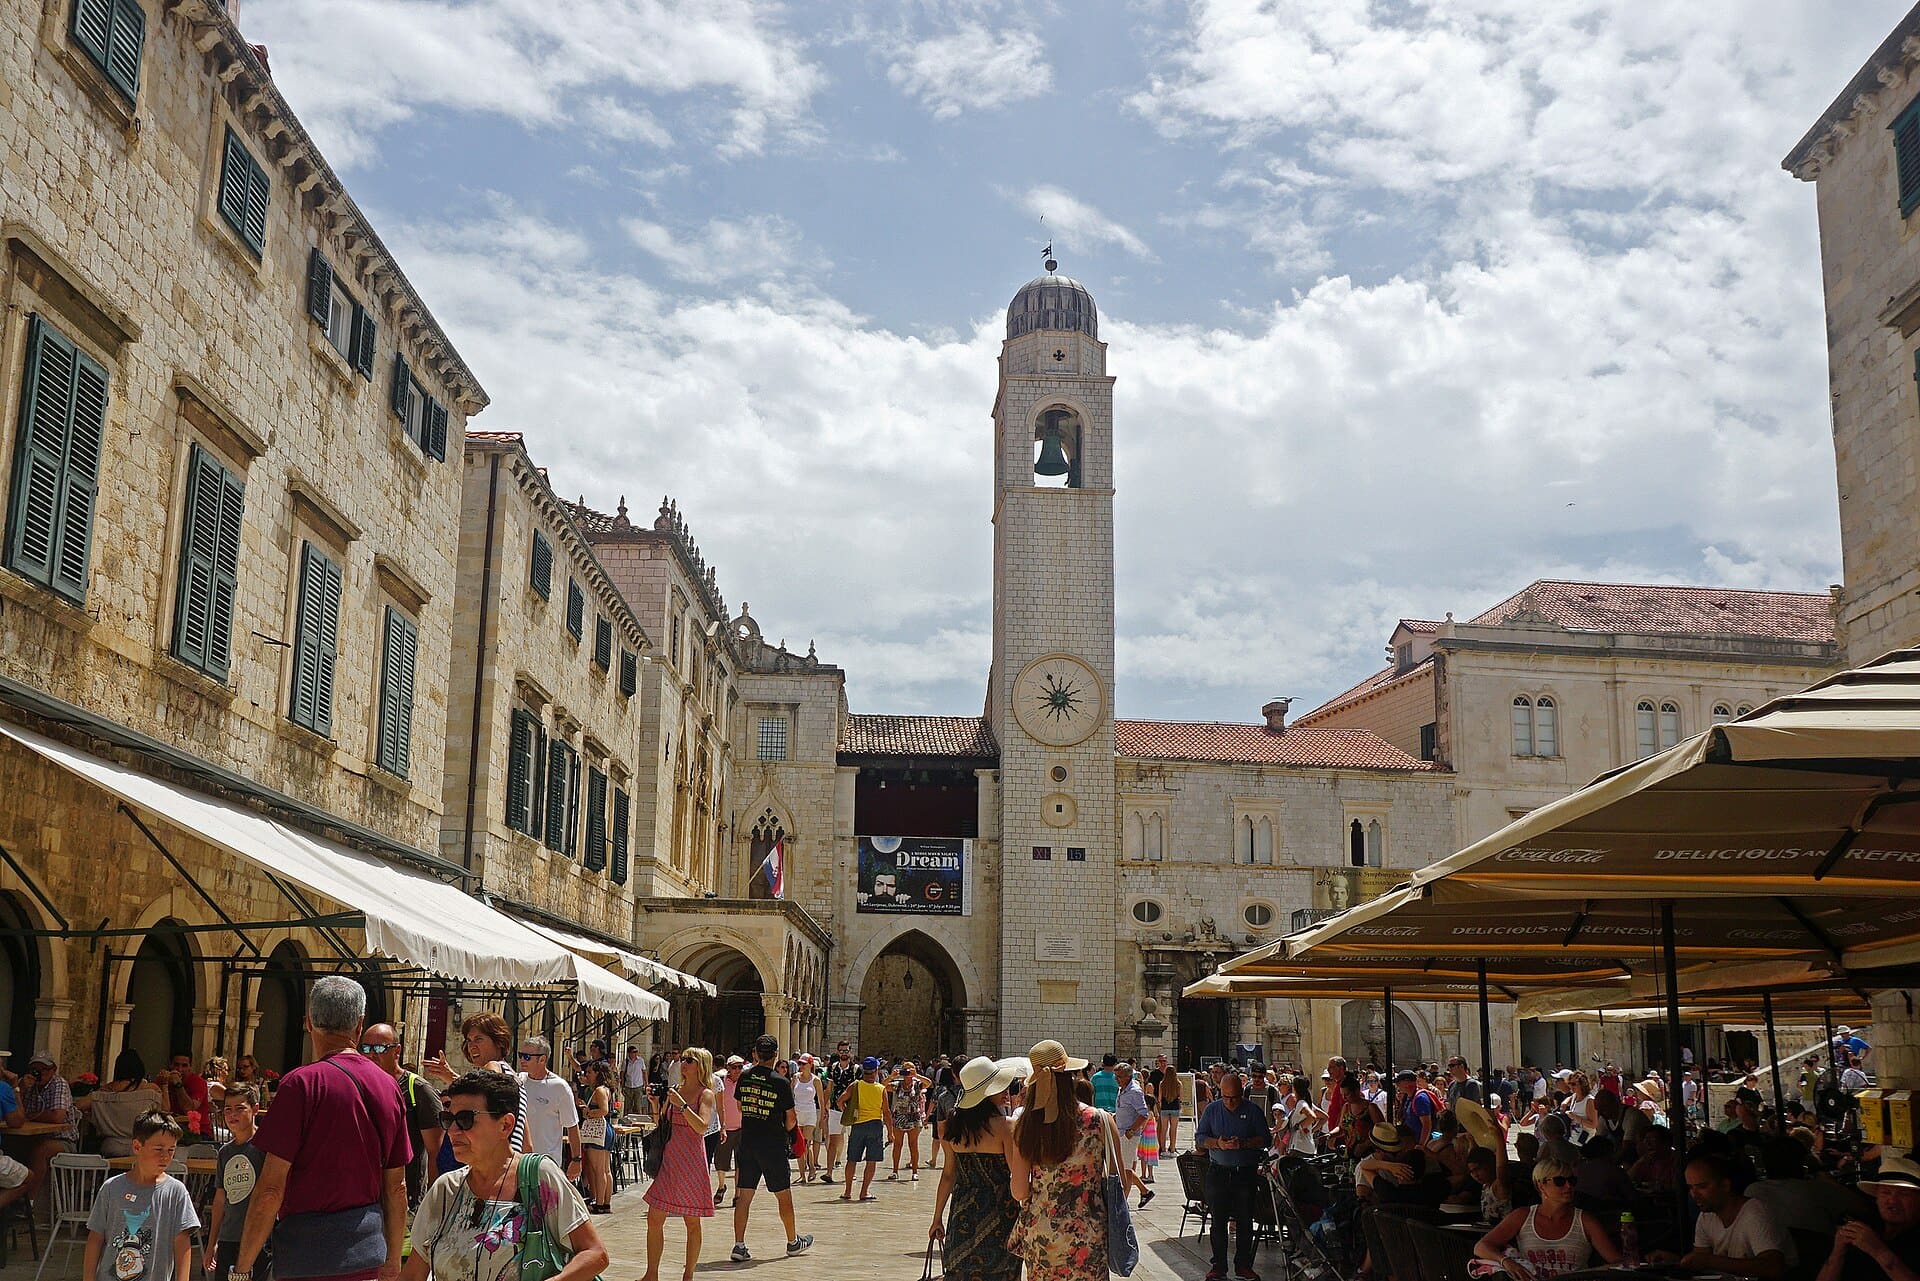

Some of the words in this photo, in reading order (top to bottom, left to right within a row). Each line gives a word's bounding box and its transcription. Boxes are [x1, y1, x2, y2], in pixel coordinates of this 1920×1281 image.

[896, 851, 960, 870] Dream
[1495, 847, 1611, 863] Coca-Cola
[1654, 848, 1801, 861] DELICIOUS
[1844, 848, 1920, 863] REFR
[1346, 926, 1425, 936] Coca-Cola
[1452, 926, 1548, 935] DELICIOUS
[1579, 925, 1695, 936] REFRESHNG
